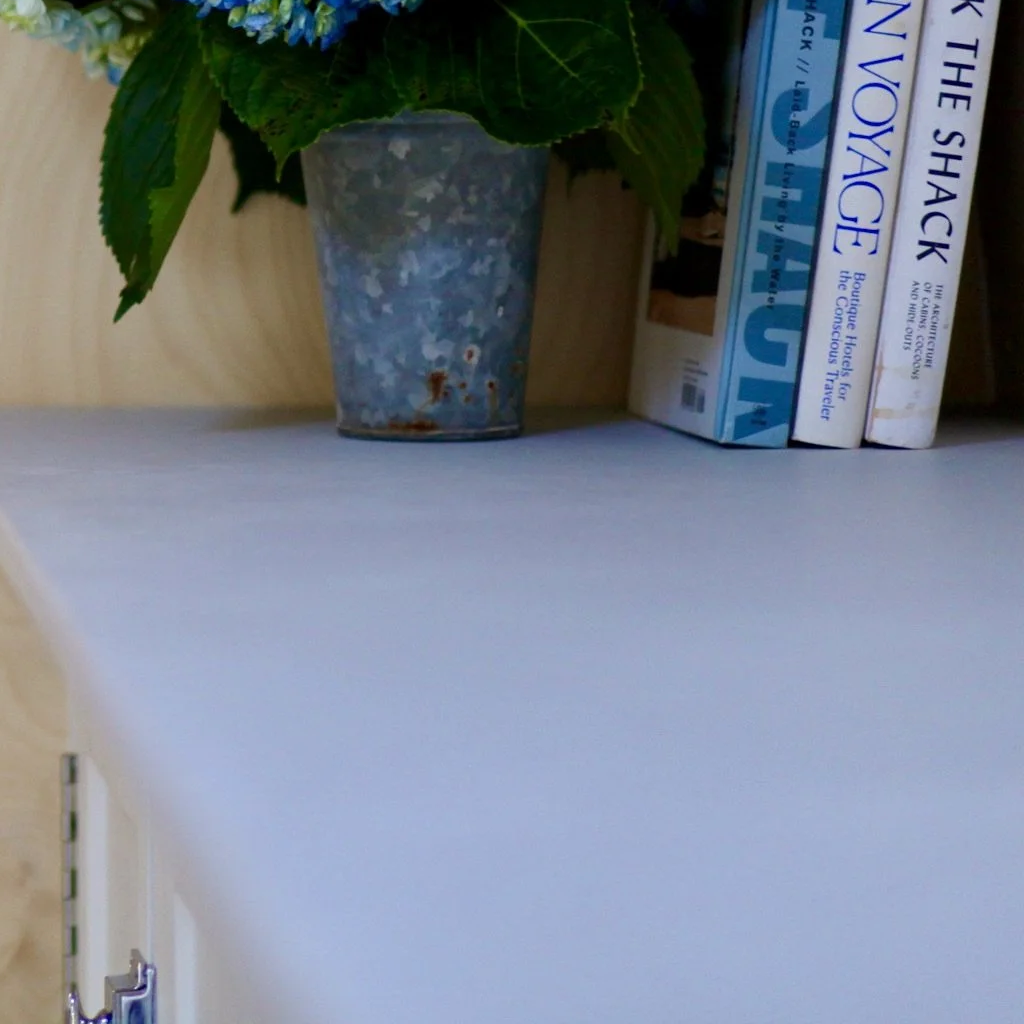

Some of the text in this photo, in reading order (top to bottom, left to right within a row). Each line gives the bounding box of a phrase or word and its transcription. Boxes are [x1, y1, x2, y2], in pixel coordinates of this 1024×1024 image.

[937, 38, 980, 112] THE
[786, 80, 805, 155] Laid-Back
[833, 53, 904, 256] VOYAGE
[916, 129, 966, 265] SHACK
[909, 280, 919, 302] AND
[922, 282, 932, 295] OF
[926, 284, 944, 369] THE ARCHITECTURE
[820, 270, 851, 421] the Conscious Traveler
[838, 272, 866, 402] Boutique Hotels for
[910, 335, 925, 380] COCOONS
